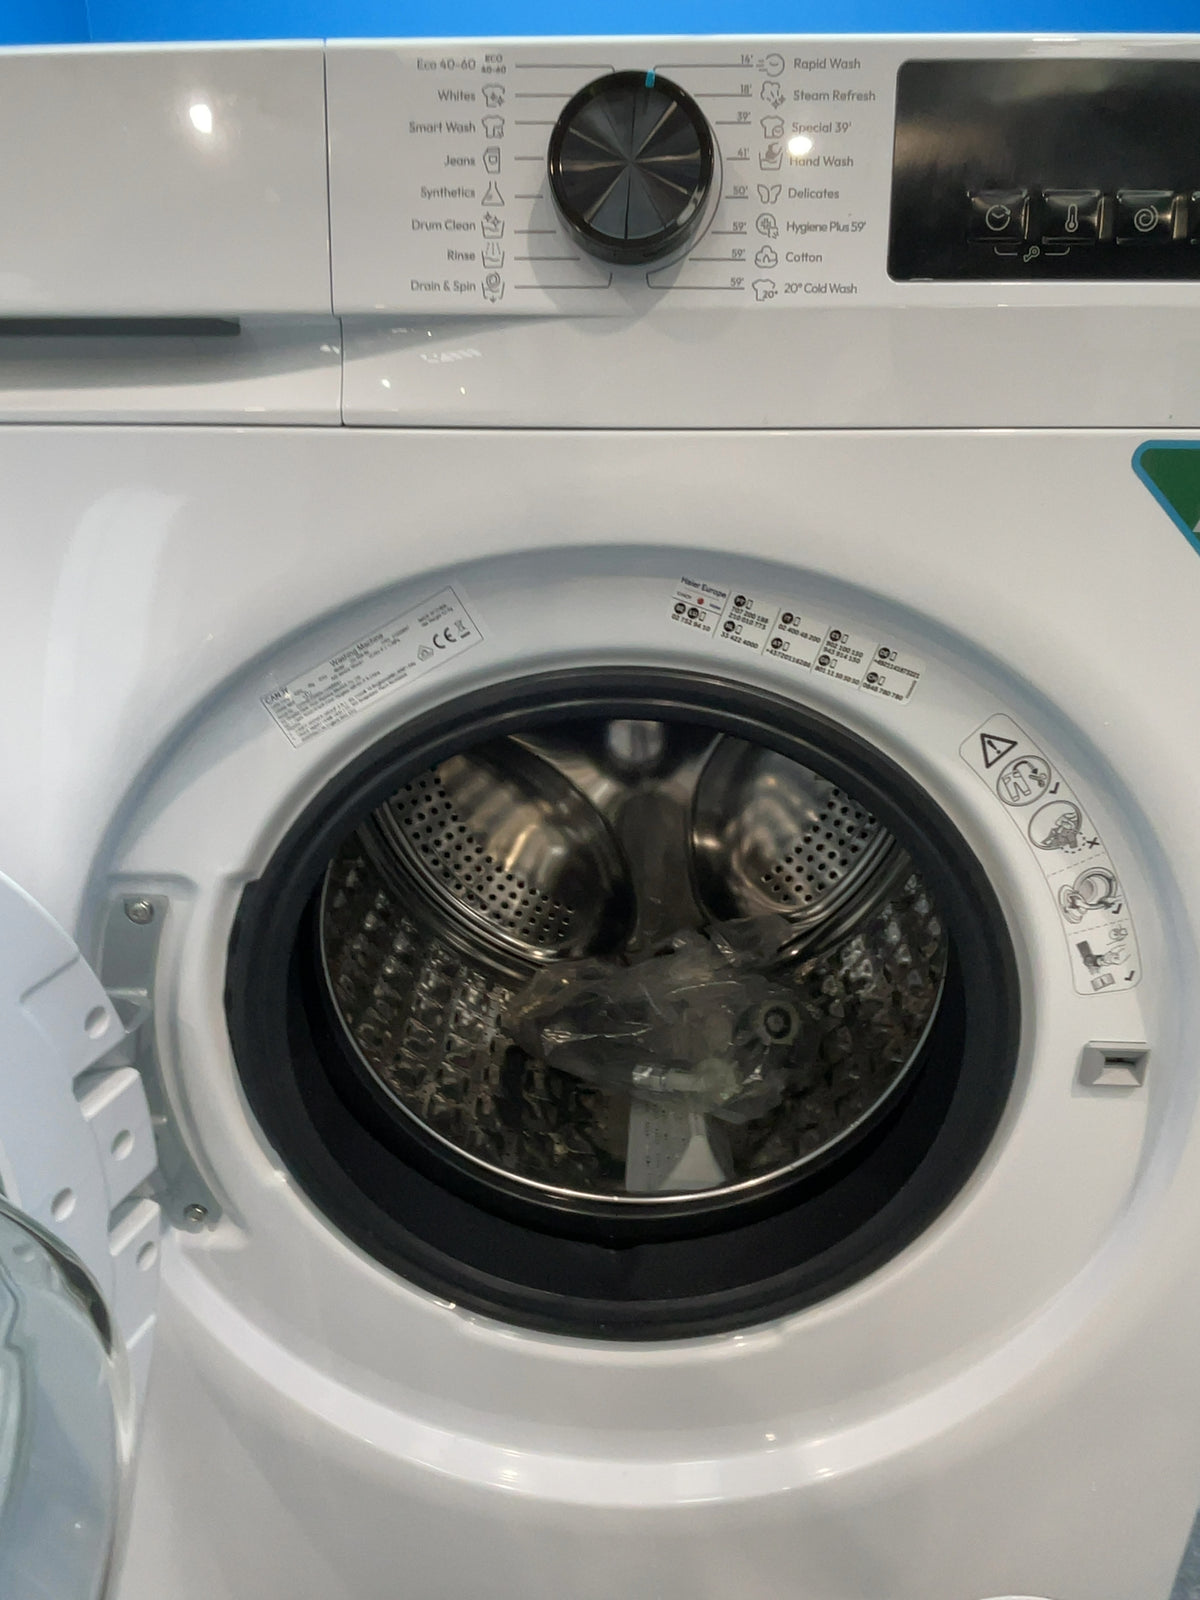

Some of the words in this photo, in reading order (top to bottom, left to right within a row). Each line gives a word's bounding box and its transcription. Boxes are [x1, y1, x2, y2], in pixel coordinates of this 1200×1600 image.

[417, 58, 437, 70] Eco
[440, 59, 476, 71] 40-60
[485, 54, 503, 63] ECO
[793, 58, 827, 71] Rapid
[830, 58, 861, 70] Wash
[438, 89, 476, 101] Whites
[793, 90, 830, 101] Steam
[832, 89, 876, 101] Refresh
[409, 122, 442, 133] Smart
[446, 121, 476, 133] Wash
[792, 121, 832, 134] Special
[835, 121, 852, 133] 39'
[444, 155, 476, 167] Jeans
[789, 155, 820, 167] Hand
[823, 156, 854, 167] Wash
[420, 186, 476, 200] Synthetics
[788, 188, 840, 199] Delicates
[411, 219, 442, 231] Drum
[445, 219, 476, 231] Clean
[786, 221, 828, 235] Hygiene
[829, 221, 850, 232] Plus
[851, 221, 867, 233] 59'
[447, 249, 476, 261] Rinse
[785, 251, 823, 263] Cotton
[410, 280, 440, 292] Drain
[443, 280, 451, 292] &
[453, 280, 476, 294] Spin
[804, 282, 828, 294] Cold
[829, 282, 858, 294] Wash
[700, 583, 727, 599] Europe
